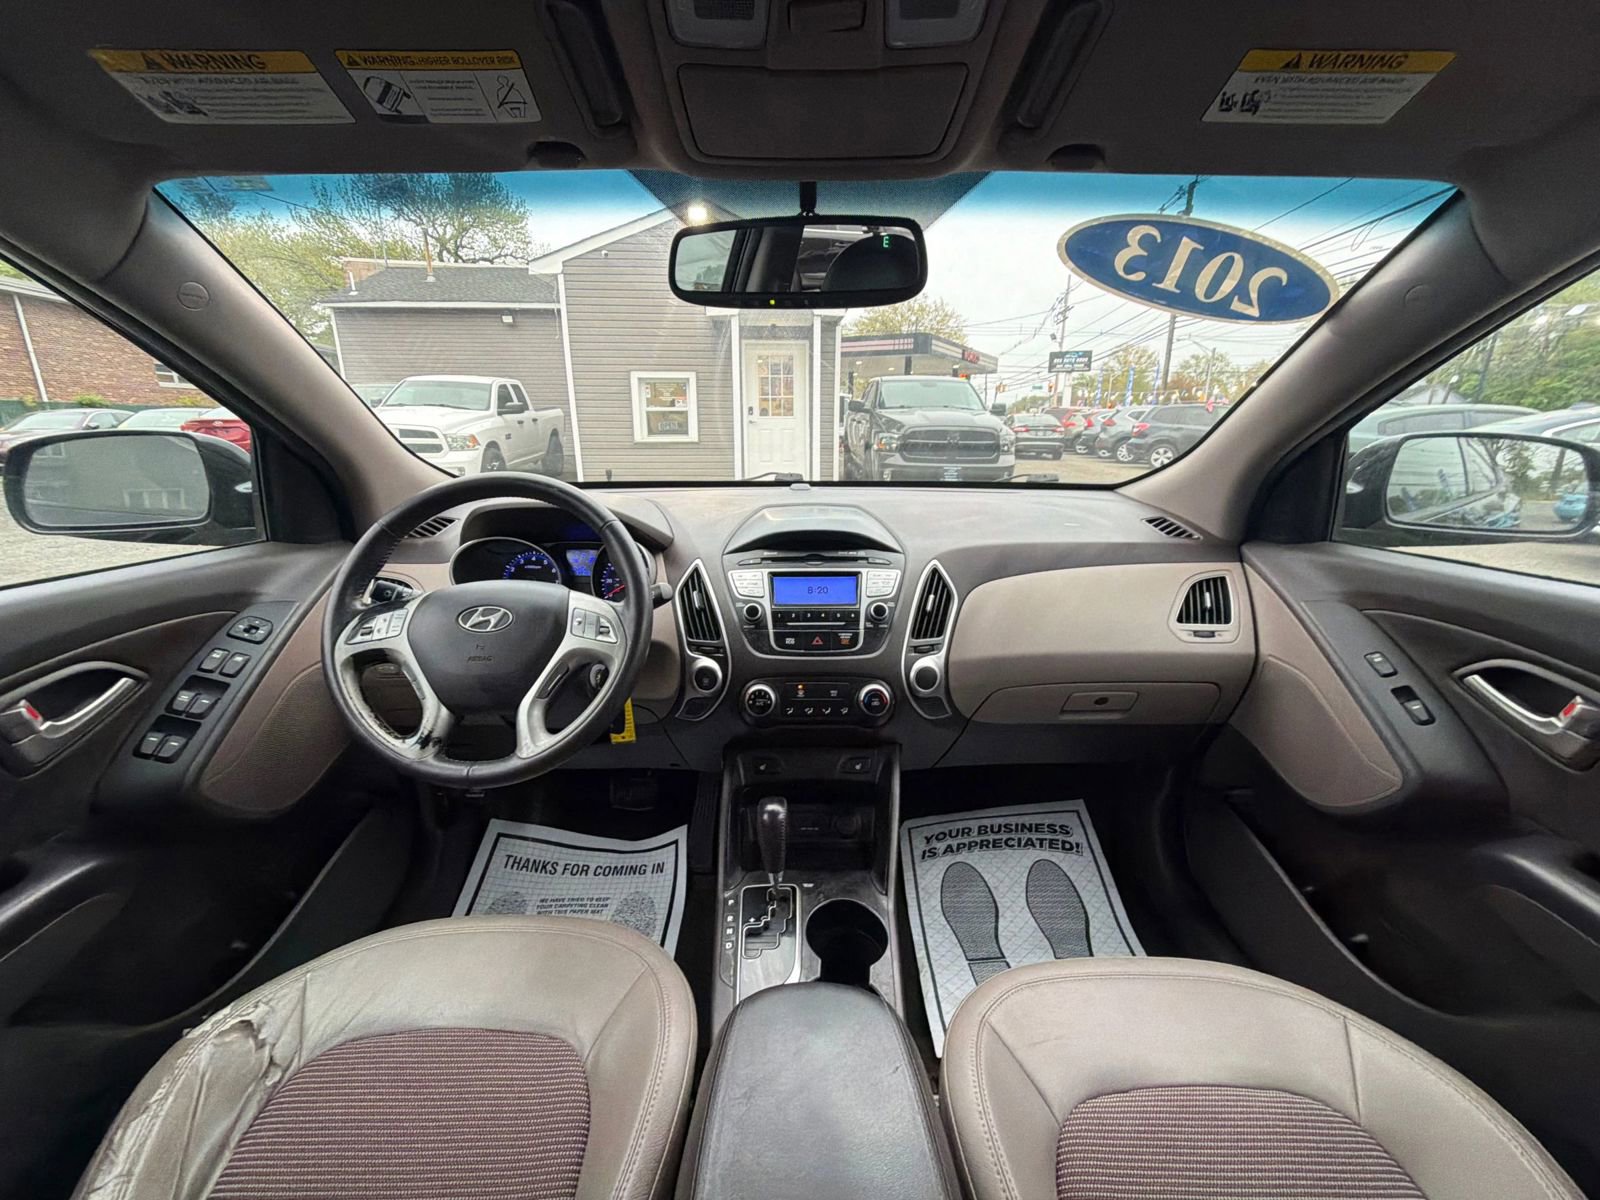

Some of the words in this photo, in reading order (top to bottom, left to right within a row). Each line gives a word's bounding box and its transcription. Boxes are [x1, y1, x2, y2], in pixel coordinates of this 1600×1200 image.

[160, 53, 267, 70] WARNING
[418, 56, 450, 65] HIGHER
[451, 56, 495, 65] ROLLOVER
[1309, 54, 1409, 70] WARNING
[882, 236, 890, 248] E
[807, 586, 829, 595] 8:20
[924, 828, 973, 845] YOUR
[977, 822, 1073, 837] BUSINESS
[921, 847, 937, 860] IS
[942, 837, 1083, 856] APPRECIATED!
[503, 854, 559, 876] THANKS
[561, 863, 590, 877] FOR
[593, 863, 647, 877] COMING
[651, 861, 665, 875] IN
